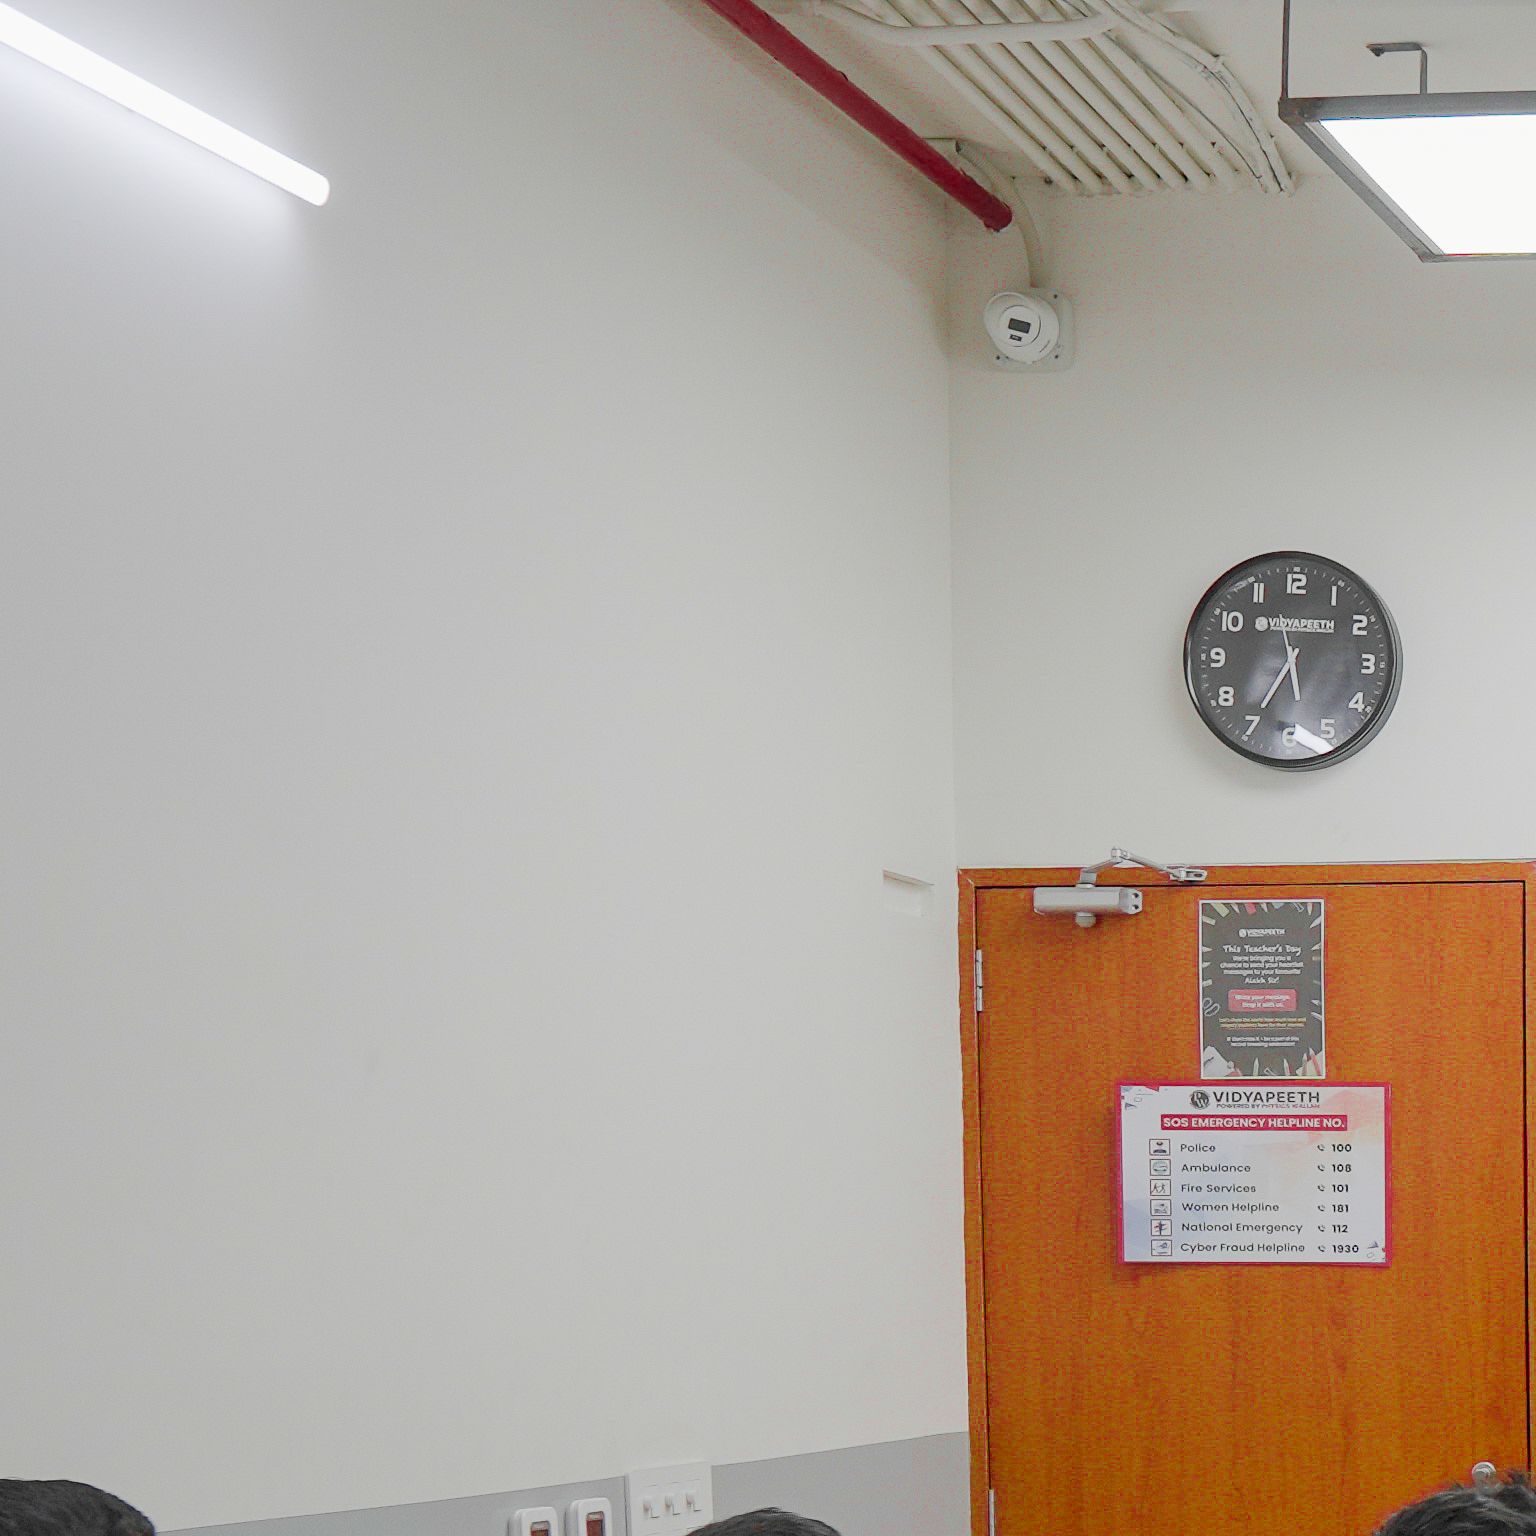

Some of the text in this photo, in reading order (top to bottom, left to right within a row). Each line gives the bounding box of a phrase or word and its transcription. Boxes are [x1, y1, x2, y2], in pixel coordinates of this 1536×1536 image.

[1253, 582, 1265, 603] 11
[1286, 573, 1307, 594] 12
[1331, 585, 1337, 607] 1
[1221, 610, 1244, 632] 10
[1268, 617, 1335, 629] VIDYAPEETH
[1352, 614, 1368, 636] 2
[1209, 647, 1226, 668] 9
[1360, 653, 1376, 675] 3
[1218, 686, 1235, 707] 8
[1348, 691, 1365, 712] 4
[1245, 715, 1261, 736] 7
[1320, 718, 1336, 739] 5
[1281, 726, 1297, 747] 6
[1212, 1091, 1320, 1102] VIDYAPEETH
[1163, 1117, 1345, 1128] SOS EMERGENCY HELPLINE NO.
[1180, 1143, 1352, 1153] Police 100
[1181, 1163, 1352, 1173] Ambulance 108
[1181, 1183, 1349, 1193] Fire Services 101
[1181, 1202, 1349, 1214] Women Helpline 181
[1181, 1222, 1348, 1234] National Emergency 112
[1181, 1242, 1359, 1254] Cyber Fraud Helpline 1930
